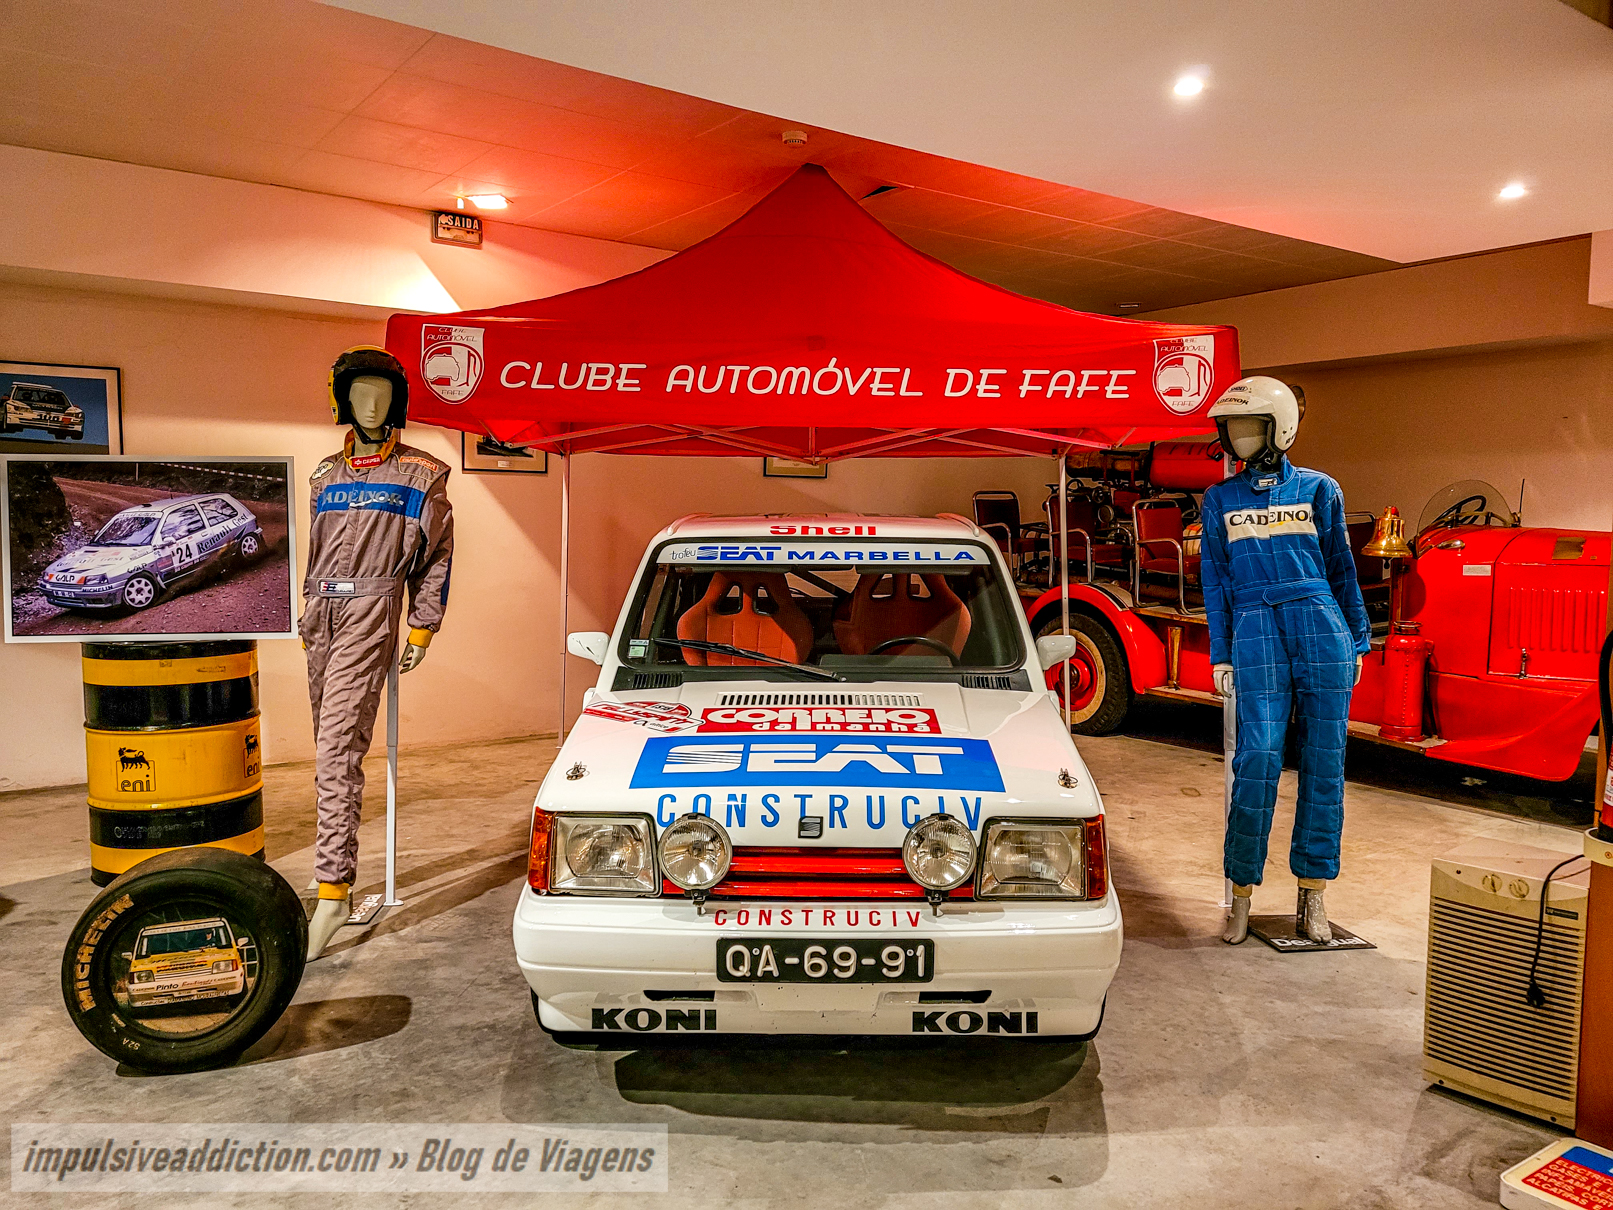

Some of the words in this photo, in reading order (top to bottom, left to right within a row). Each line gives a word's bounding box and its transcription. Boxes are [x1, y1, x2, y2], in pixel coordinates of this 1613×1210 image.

[500, 361, 647, 392] CLUBE
[666, 357, 923, 396] AUTOMÓVEL
[944, 368, 1008, 398] DE
[1019, 370, 1136, 399] FAFE
[196, 524, 232, 554] Renault
[770, 526, 876, 536] Shell
[176, 543, 193, 565] 24
[670, 547, 697, 561] trofeu
[696, 546, 782, 561] SEAT
[787, 550, 976, 561] MARBELLA
[55, 574, 75, 583] GALP
[707, 709, 931, 730] CORREIO
[752, 721, 792, 731] da
[816, 722, 931, 732] manhã
[662, 743, 965, 775] SEAT
[120, 774, 151, 792] eni
[714, 909, 922, 928] CONSTRUCIV
[75, 893, 135, 1013] MICHELIN
[156, 983, 179, 991] Pinto
[591, 1008, 717, 1031] KONI
[911, 1011, 1038, 1034] KONI
[1549, 1164, 1589, 1183] GASES
